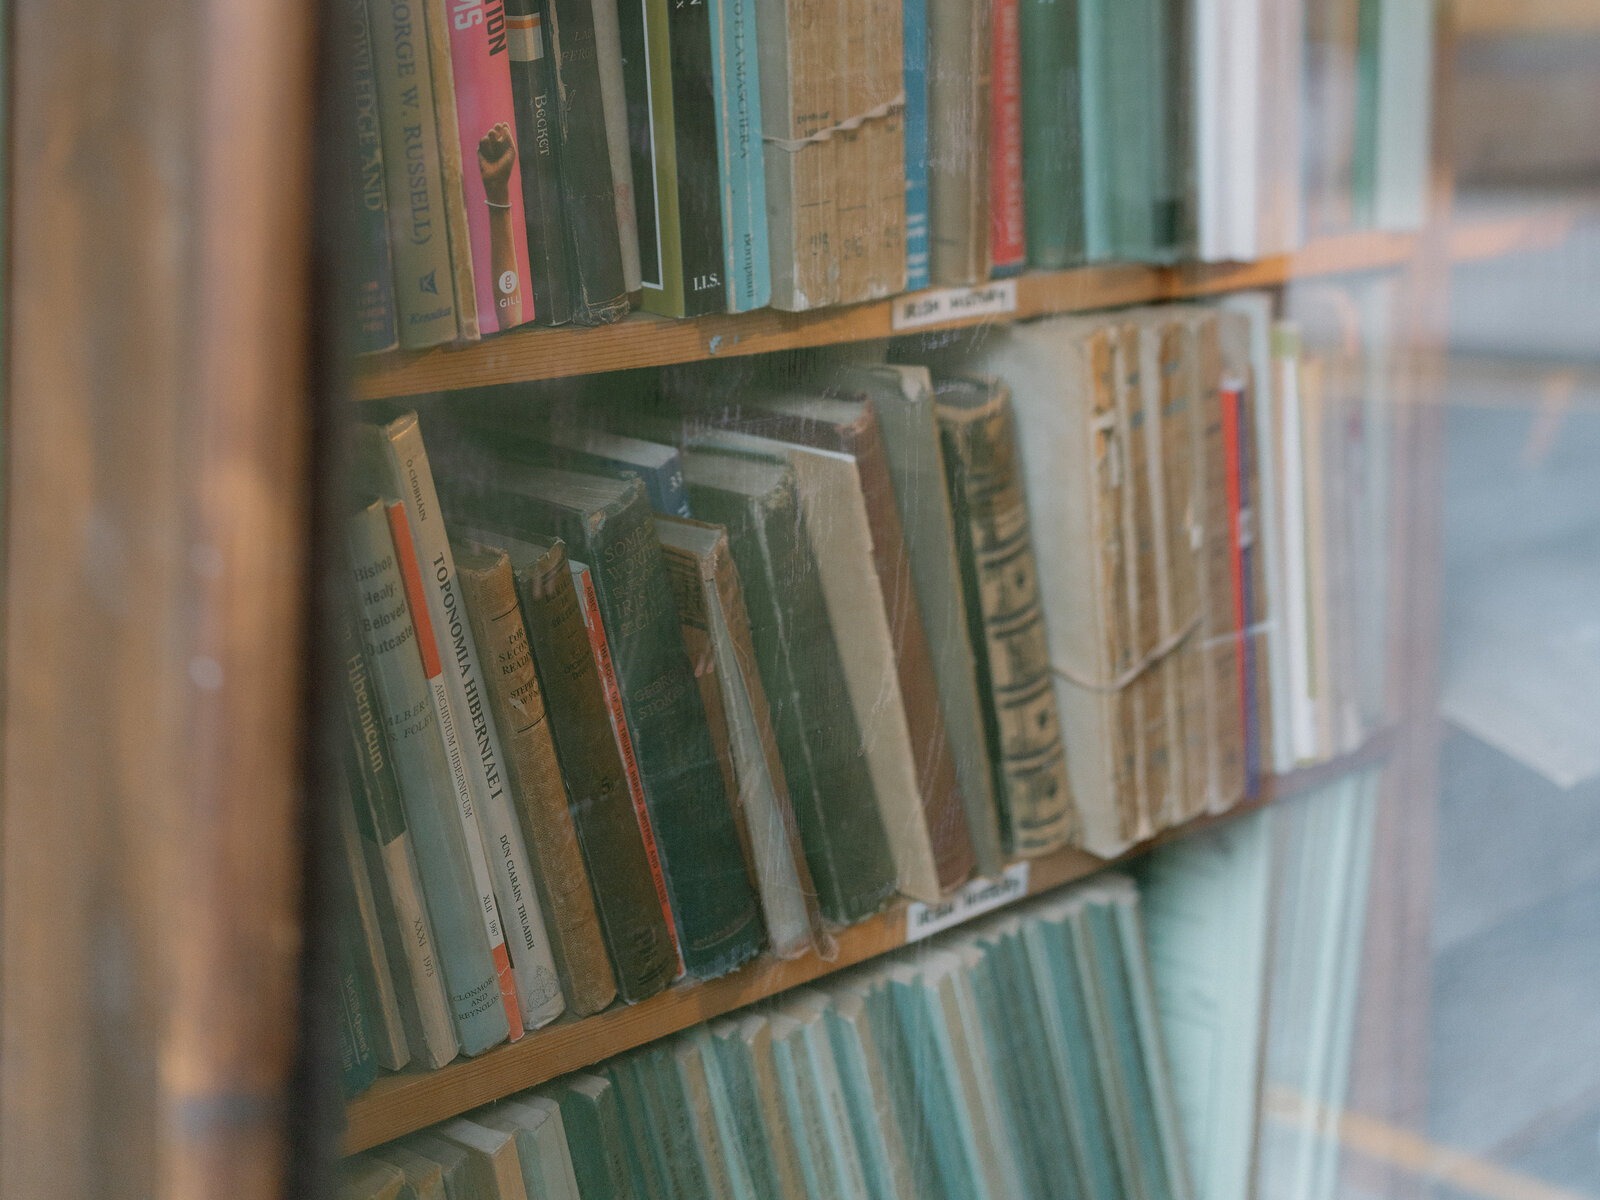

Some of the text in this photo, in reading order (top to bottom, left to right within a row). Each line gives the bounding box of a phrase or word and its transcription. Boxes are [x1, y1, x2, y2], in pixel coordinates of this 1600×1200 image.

[400, 84, 420, 118] W.
[403, 124, 433, 245] RUSSELL)
[499, 295, 521, 309] GILL
[353, 555, 393, 583] Bishop
[362, 600, 407, 634] Beloved
[347, 652, 385, 773] Hibernicum
[433, 552, 472, 678] TOPONOMIA
[463, 676, 501, 789] HIBERNIAE
[599, 641, 608, 659] THE
[604, 663, 614, 686] BOOK
[615, 707, 624, 722] THE
[620, 727, 634, 768] TRIUMPH
[434, 683, 499, 938] ARCHIVIUM HIBERNICUM XLII 1987
[499, 834, 512, 861] DÚN
[517, 903, 535, 950] THUAIDH
[413, 917, 435, 978] XXXI 1973
[471, 992, 488, 1008] AND
